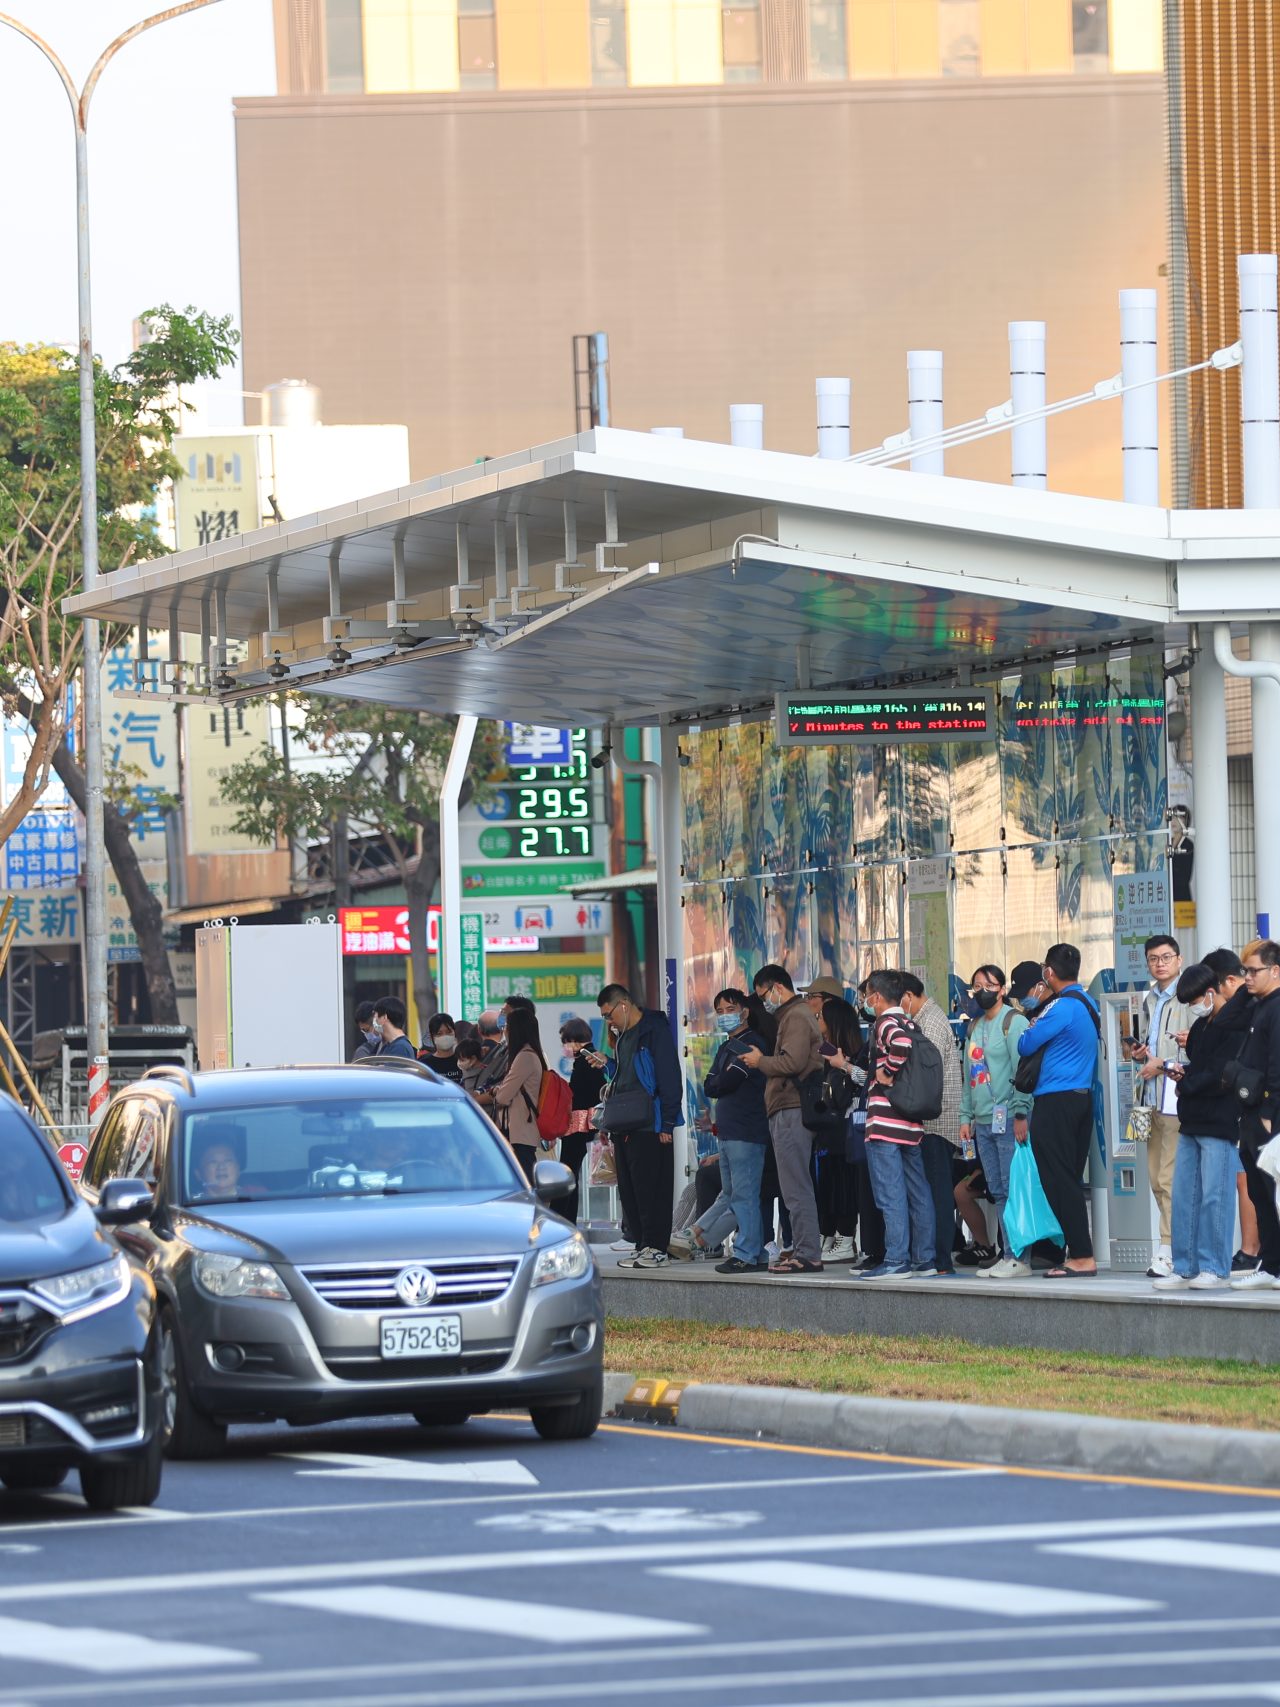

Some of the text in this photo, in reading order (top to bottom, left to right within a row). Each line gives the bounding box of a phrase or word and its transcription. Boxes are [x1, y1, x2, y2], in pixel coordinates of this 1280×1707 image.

[806, 721, 865, 732] Minutes
[871, 720, 889, 731] to
[896, 719, 921, 730] the
[928, 717, 986, 729] station
[520, 788, 588, 818] 29.5
[520, 826, 589, 857] 27.7
